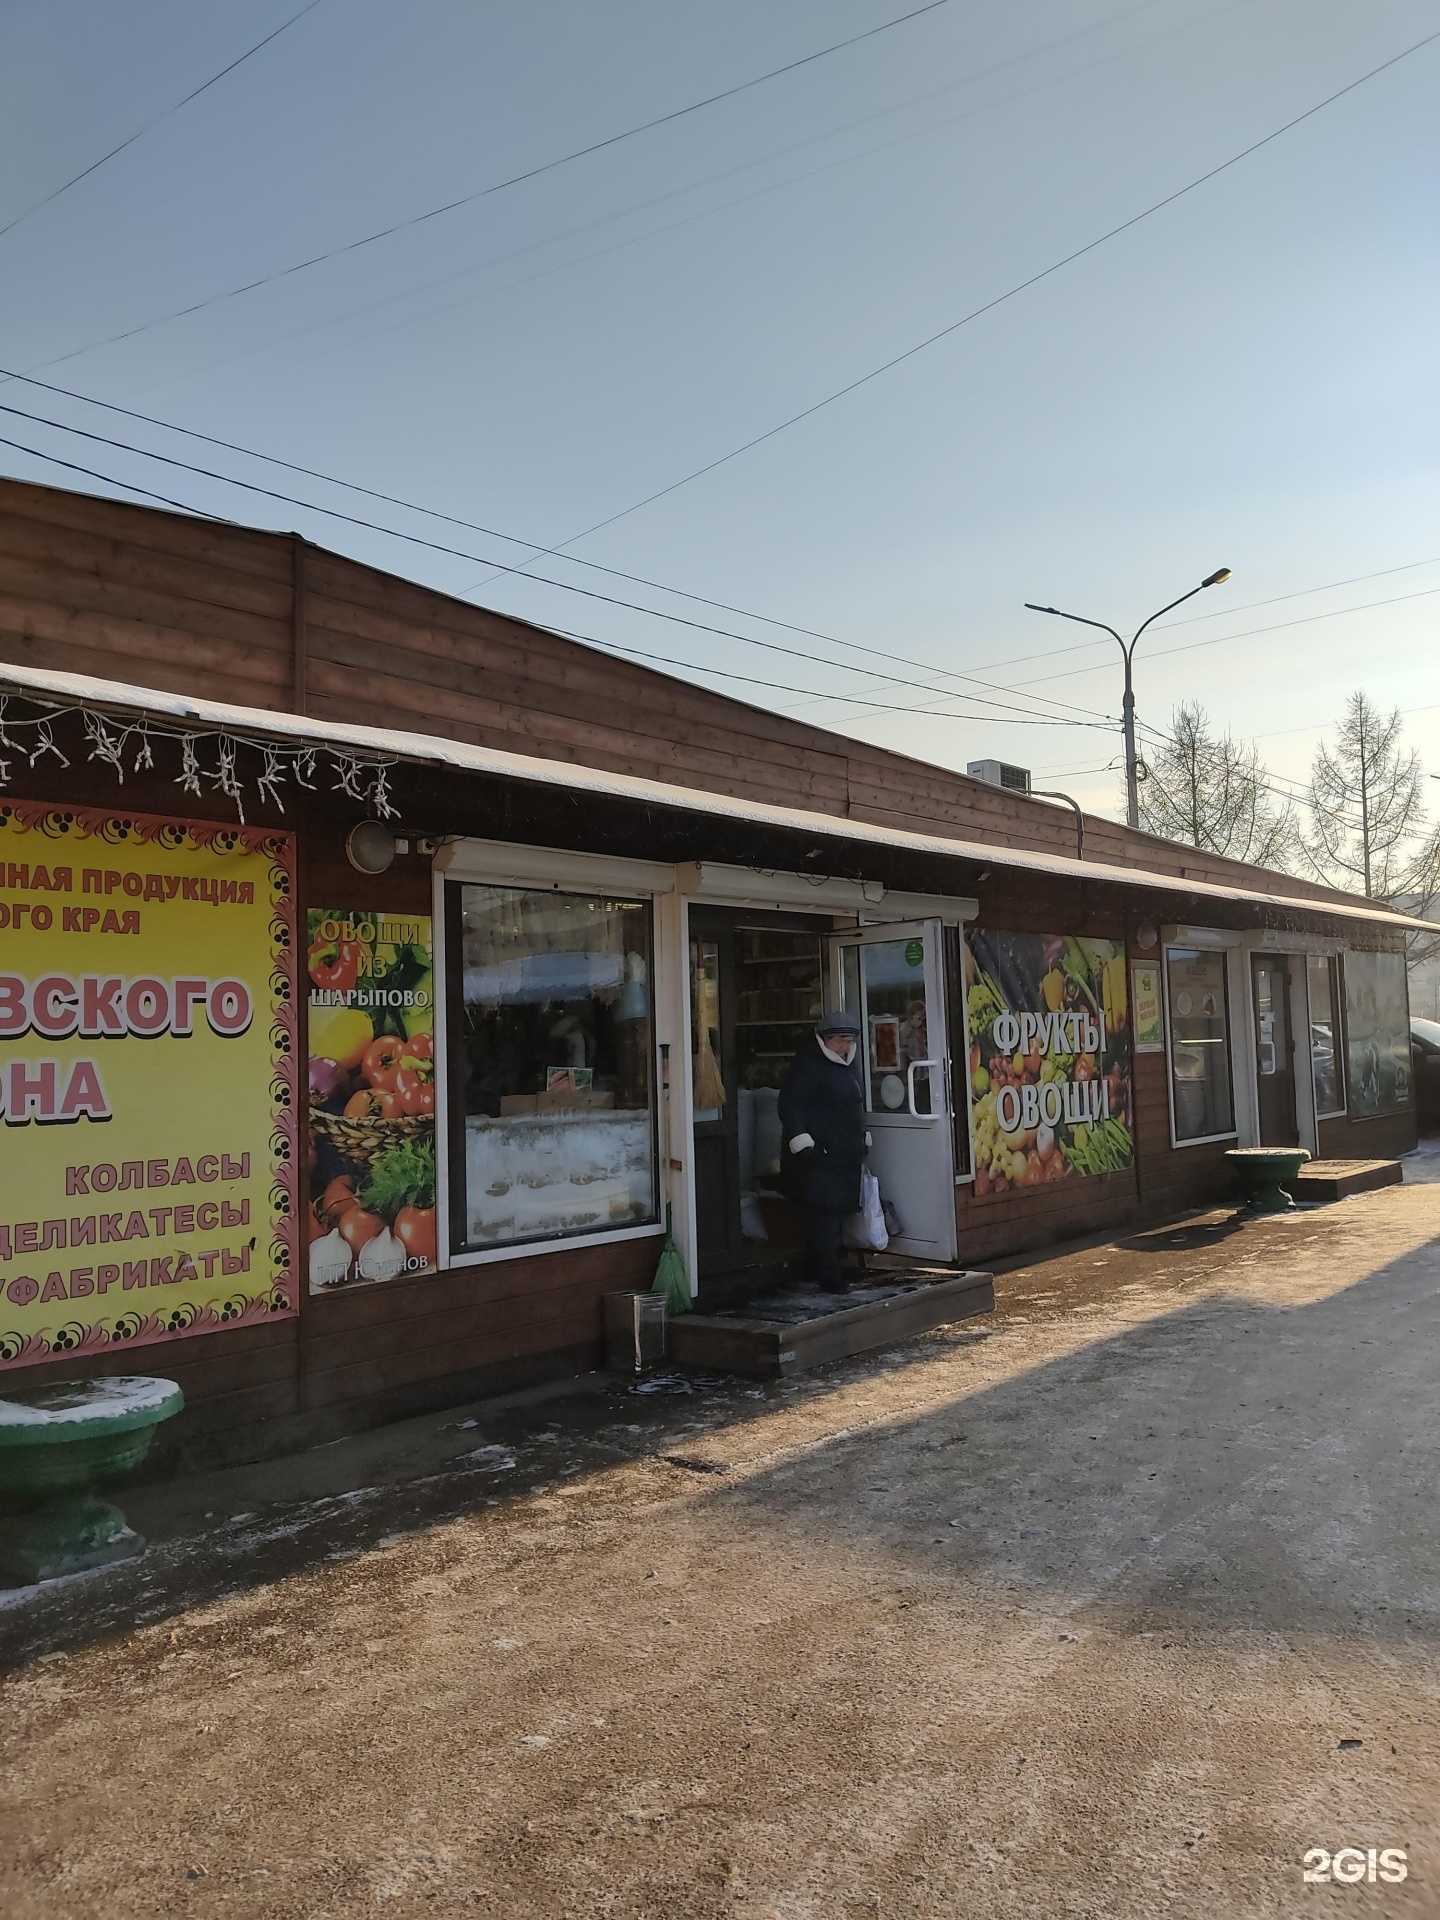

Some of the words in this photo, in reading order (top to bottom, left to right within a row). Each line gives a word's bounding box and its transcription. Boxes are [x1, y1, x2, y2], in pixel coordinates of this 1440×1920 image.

[82, 868, 255, 906] ПРОДУКЦИЯ
[62, 906, 140, 935] КРАЯ
[320, 919, 419, 949] ОВОЩИ
[356, 953, 388, 978] ИЗ
[311, 987, 429, 1007] ШАРЫПОВО
[992, 1008, 1107, 1056] ФРУКТЫ
[0, 1058, 112, 1127] НА
[996, 1079, 1110, 1132] ОВОЩИ
[65, 1152, 250, 1195] КОЛБАСЫ
[0, 1245, 251, 1306] ФАБРИКАТЫ
